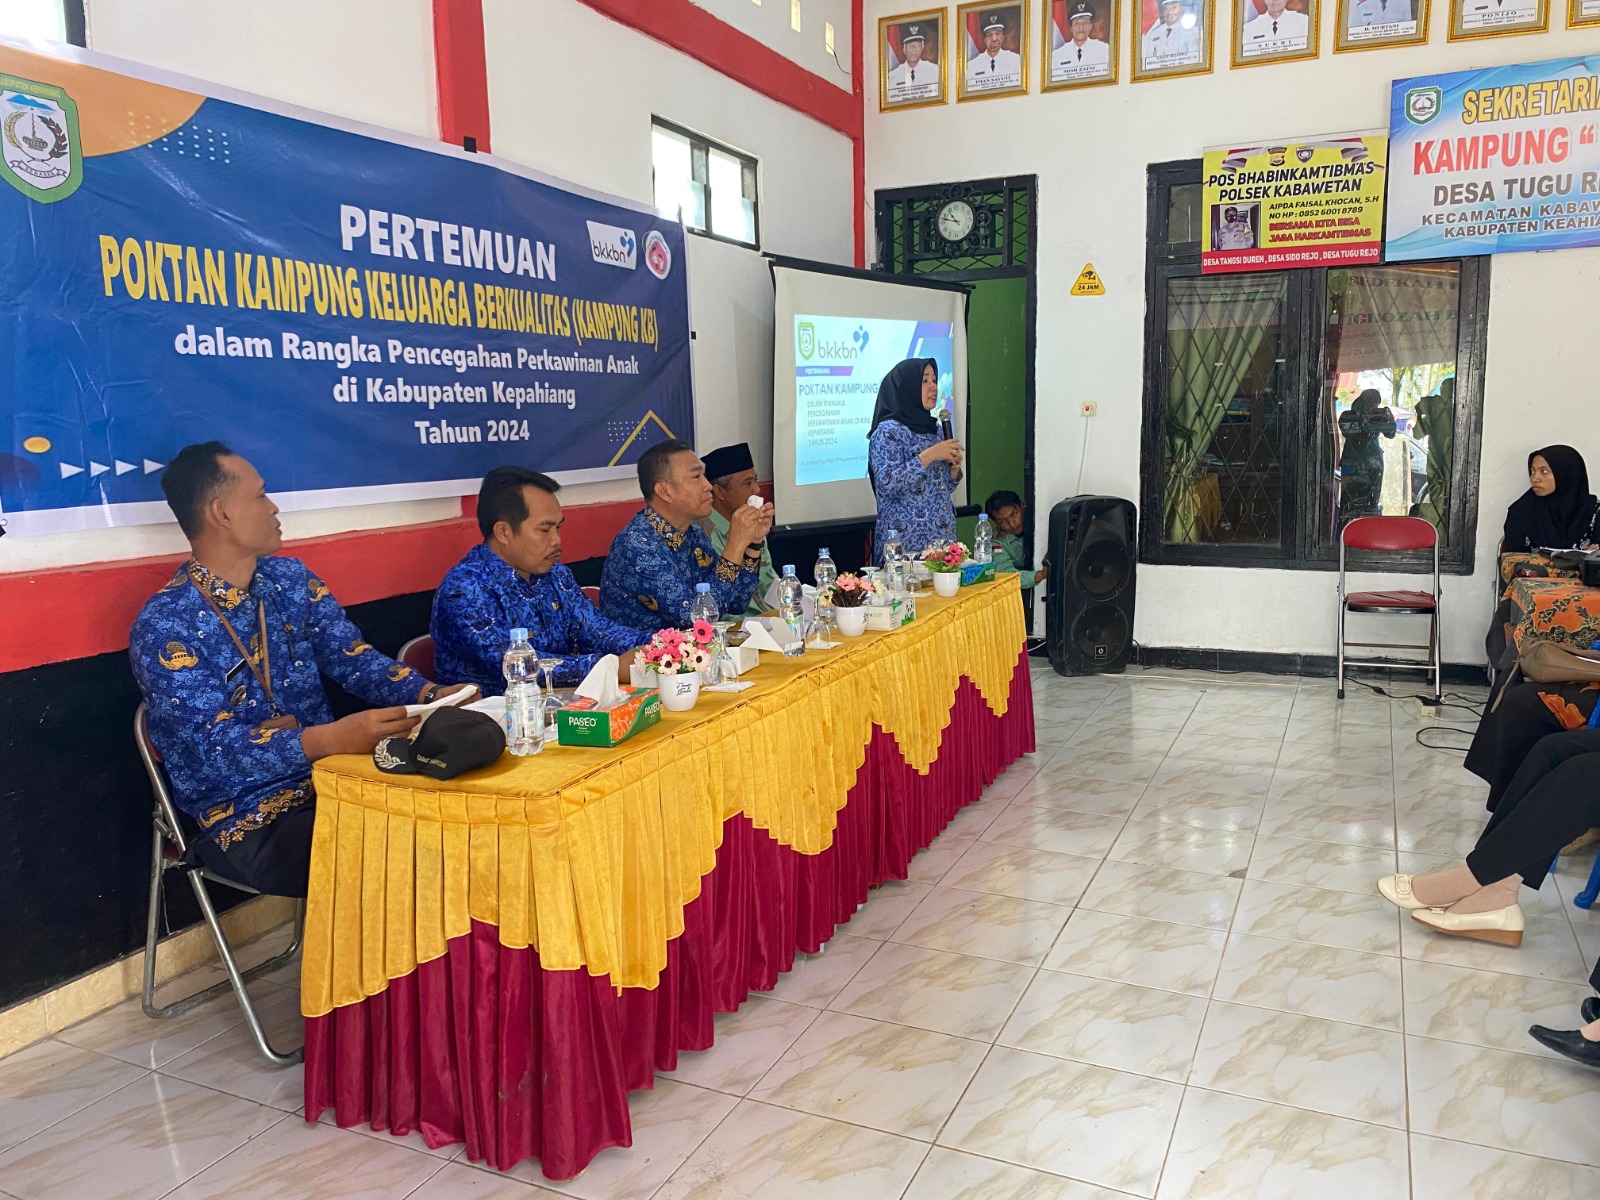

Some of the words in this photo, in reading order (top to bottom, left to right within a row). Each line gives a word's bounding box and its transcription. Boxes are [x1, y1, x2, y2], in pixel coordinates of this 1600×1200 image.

[1461, 75, 1600, 125] SEKRETARI
[1413, 126, 1570, 176] KAMPUNG
[1208, 174, 1236, 188] POS
[1237, 160, 1376, 186] BHABINKAMTIBMAS
[1218, 186, 1271, 202] POLSEK
[1273, 178, 1363, 199] KABAWETAN
[1433, 180, 1496, 207] DESA
[1503, 173, 1573, 200] TUGU
[1580, 170, 1600, 194] R
[1269, 220, 1314, 231] BERSAMA
[1314, 218, 1337, 228] KITA
[1298, 209, 1319, 217] 0852
[1421, 205, 1532, 226] KECAMATAN
[1444, 220, 1538, 239] KABUPATEN
[340, 204, 556, 281] PERTEMUAN
[592, 240, 626, 263] bkkbn
[1203, 258, 1219, 266] DESA
[1219, 257, 1242, 266] TANGSI
[1242, 255, 1265, 264] DUREN
[1268, 254, 1285, 263] DESA
[1285, 253, 1301, 261] SIDO
[1301, 252, 1319, 260] REJO
[1323, 250, 1340, 259] DESA
[1340, 249, 1359, 258] TUGU
[1359, 248, 1378, 257] REJO
[99, 234, 229, 307] POKTAN
[234, 252, 364, 319] KAMPUNG
[364, 269, 472, 328] KELUARGA
[473, 283, 572, 338] BERKUALITAS
[572, 300, 639, 346] (KAMPUNG
[640, 307, 659, 352] KB)
[174, 324, 274, 359] dalam
[281, 332, 382, 369] Rangka
[388, 339, 512, 373] Pencegahan
[517, 352, 603, 373] Perkawinan
[606, 354, 639, 375] Anak
[818, 341, 857, 359] bkkbn
[333, 376, 358, 403] di
[366, 377, 488, 409] Kabupaten
[492, 381, 576, 410] Kepahiang
[799, 383, 833, 396] POKTAN
[835, 382, 879, 395] KAMPUNG
[414, 420, 482, 445] Tahun
[487, 419, 530, 442] 2024
[568, 716, 597, 727] PASEO
